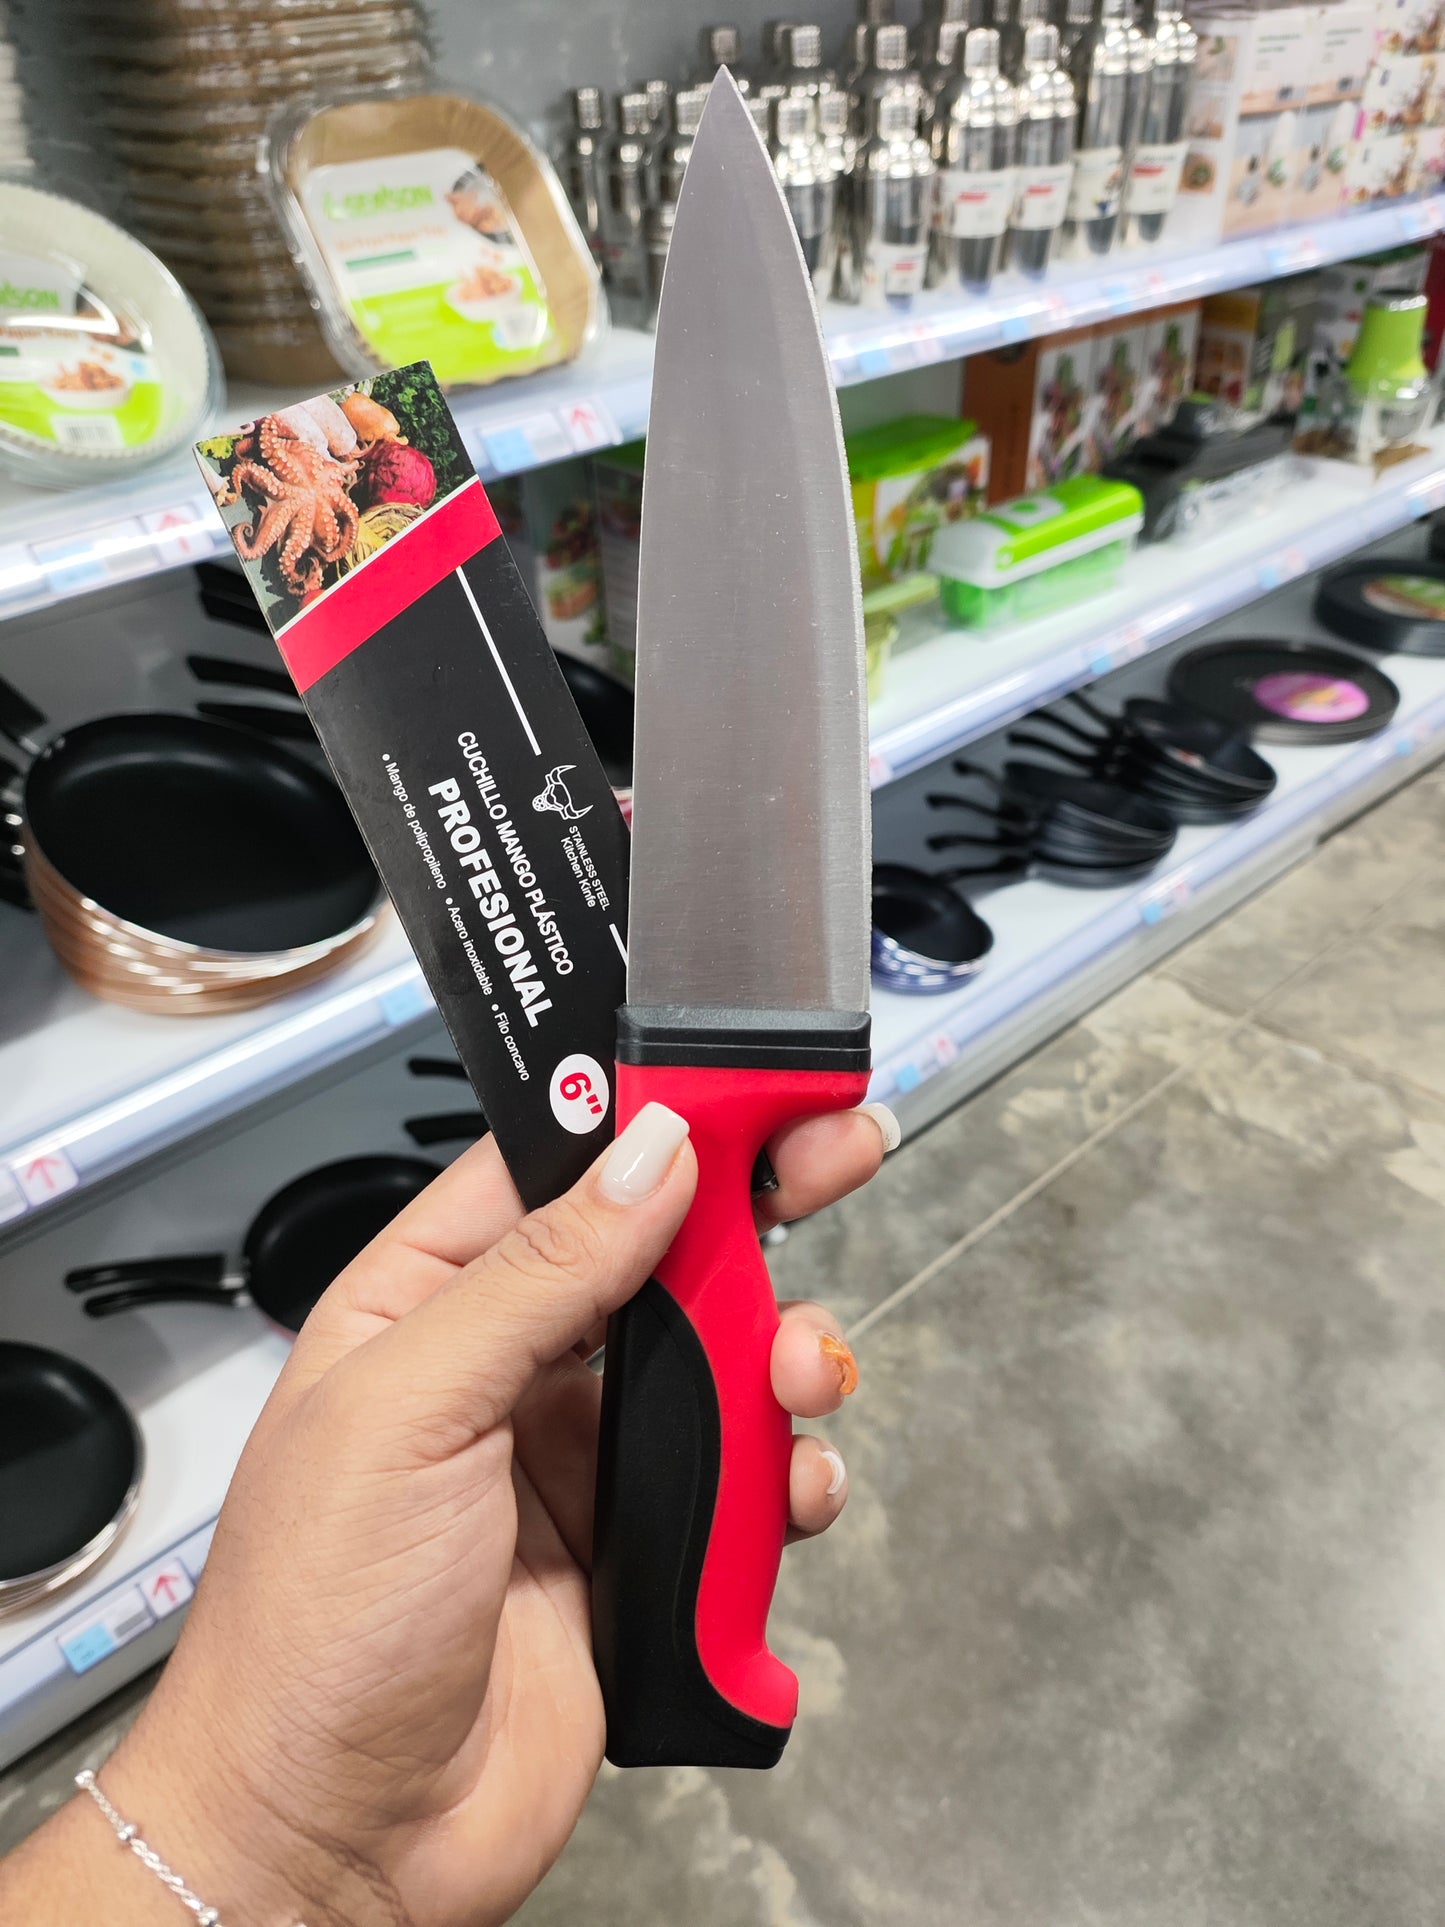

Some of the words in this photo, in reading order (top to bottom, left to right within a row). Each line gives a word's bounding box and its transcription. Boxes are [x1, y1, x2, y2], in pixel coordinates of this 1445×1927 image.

[385, 762, 409, 802] Mango
[403, 803, 416, 819] de
[407, 819, 447, 889] polipropileno
[457, 731, 507, 820] CUCHILLO
[495, 820, 536, 888] MANGO
[525, 888, 574, 975] PLÁSTICO
[560, 836, 583, 878] Kitchen
[578, 878, 596, 907] Kinfe
[568, 825, 597, 878] STAINLESS
[592, 879, 610, 911] STEEL
[428, 777, 553, 1028] PROFESIONAL
[448, 907, 468, 939] Acero
[463, 939, 493, 995] inoxidable
[494, 1012, 509, 1034] Filo
[504, 1035, 530, 1081] concavo
[559, 1072, 603, 1115] 6"
